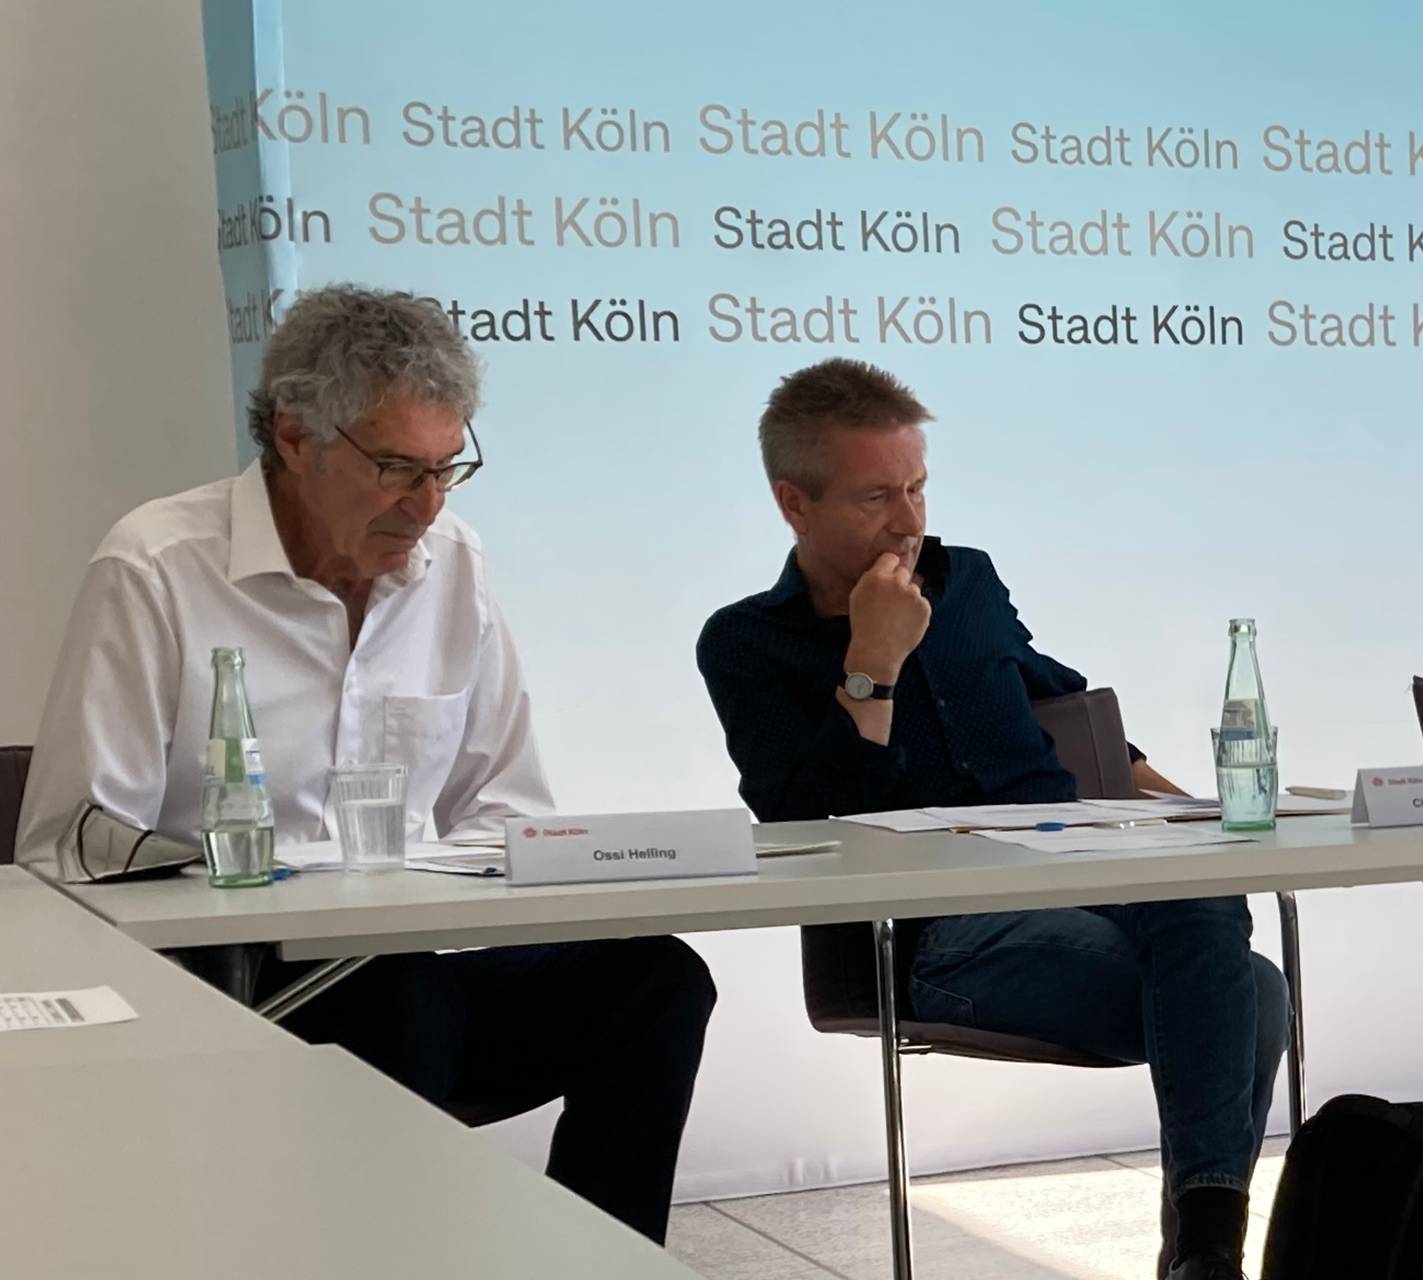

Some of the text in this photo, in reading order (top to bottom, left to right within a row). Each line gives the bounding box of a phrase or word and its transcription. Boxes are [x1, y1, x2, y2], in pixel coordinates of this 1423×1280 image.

[253, 88, 371, 145] Köln
[402, 100, 545, 150] Stadt
[562, 106, 670, 153] Köln
[698, 103, 852, 159] Stadt
[869, 111, 985, 163] Köln
[1010, 121, 1133, 167] Stadt
[1146, 126, 1238, 170] Köln
[1262, 124, 1393, 176] Stadt
[368, 191, 536, 247] Stadt
[554, 196, 680, 248] Köln
[714, 205, 846, 251] Stadt
[860, 209, 960, 254] Köln
[991, 206, 1132, 257] Stadt
[1148, 209, 1254, 259] Köln
[1282, 219, 1395, 262] Stadt
[419, 297, 555, 342] tadt
[571, 298, 680, 343] Köln
[708, 292, 860, 344] Stadt
[877, 295, 992, 345] Köln
[1018, 303, 1139, 345] Stadt
[1152, 304, 1243, 346] Köln
[1267, 299, 1397, 348] Stadt
[593, 847, 677, 861] Ossi Helling
